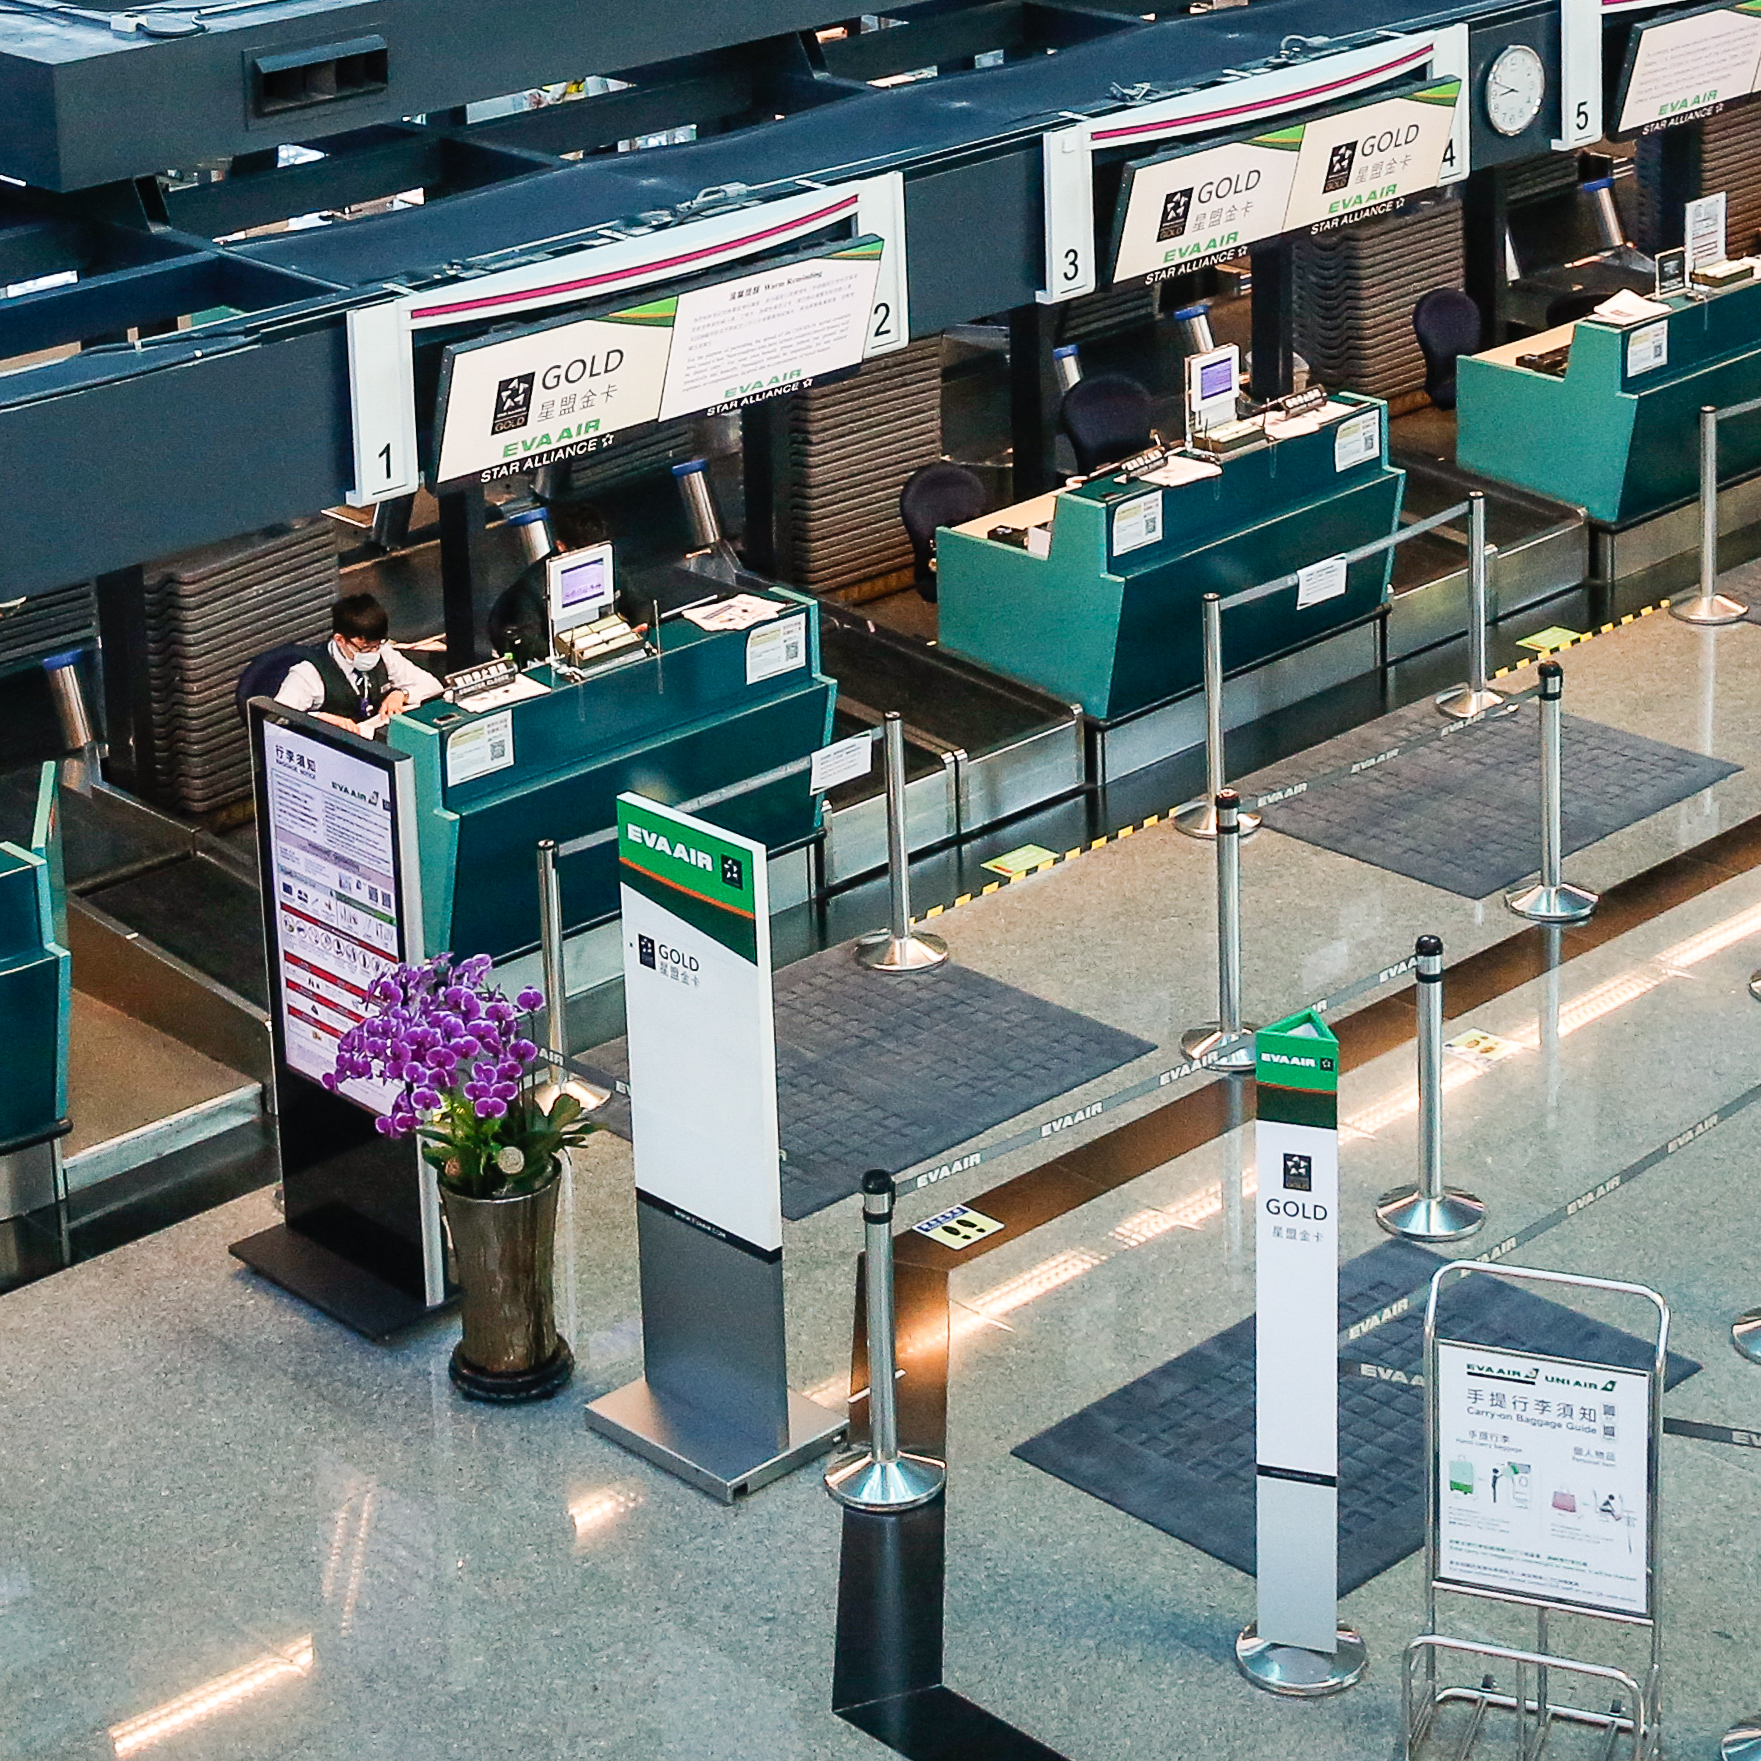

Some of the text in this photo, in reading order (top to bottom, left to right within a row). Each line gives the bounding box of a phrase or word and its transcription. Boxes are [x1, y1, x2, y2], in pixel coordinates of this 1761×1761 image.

[1575, 101, 1589, 130] 5
[1642, 106, 1713, 136] STAR ALLIANCE
[1360, 123, 1420, 158] GOLD
[1354, 154, 1413, 185] 星盟金卡
[1197, 169, 1261, 204] GOLD
[1191, 200, 1254, 233] 星盟金卡
[1311, 202, 1394, 235] STAR ALLIANCE
[1063, 248, 1079, 281] 3
[1145, 251, 1235, 285] STAR ALLIANCE
[873, 302, 891, 337] 2
[541, 348, 624, 391] GOLD
[537, 383, 618, 422] 星盟金卡
[706, 382, 799, 417] STAR ALLIANCE
[494, 416, 525, 432] GOLD
[378, 442, 391, 479] 1
[480, 439, 597, 484] STAR ALLIANCE
[275, 744, 316, 772] 行李須知
[659, 944, 700, 972] GOLD
[1378, 956, 1418, 982] EVAA
[1266, 1198, 1328, 1221] GOLD
[1272, 1225, 1324, 1243] 星盟金卡
[1360, 1364, 1425, 1388] EVAA
[1466, 1406, 1596, 1435] Carry-on Baggage Guide
[1467, 1388, 1597, 1423] 手提行李須知
